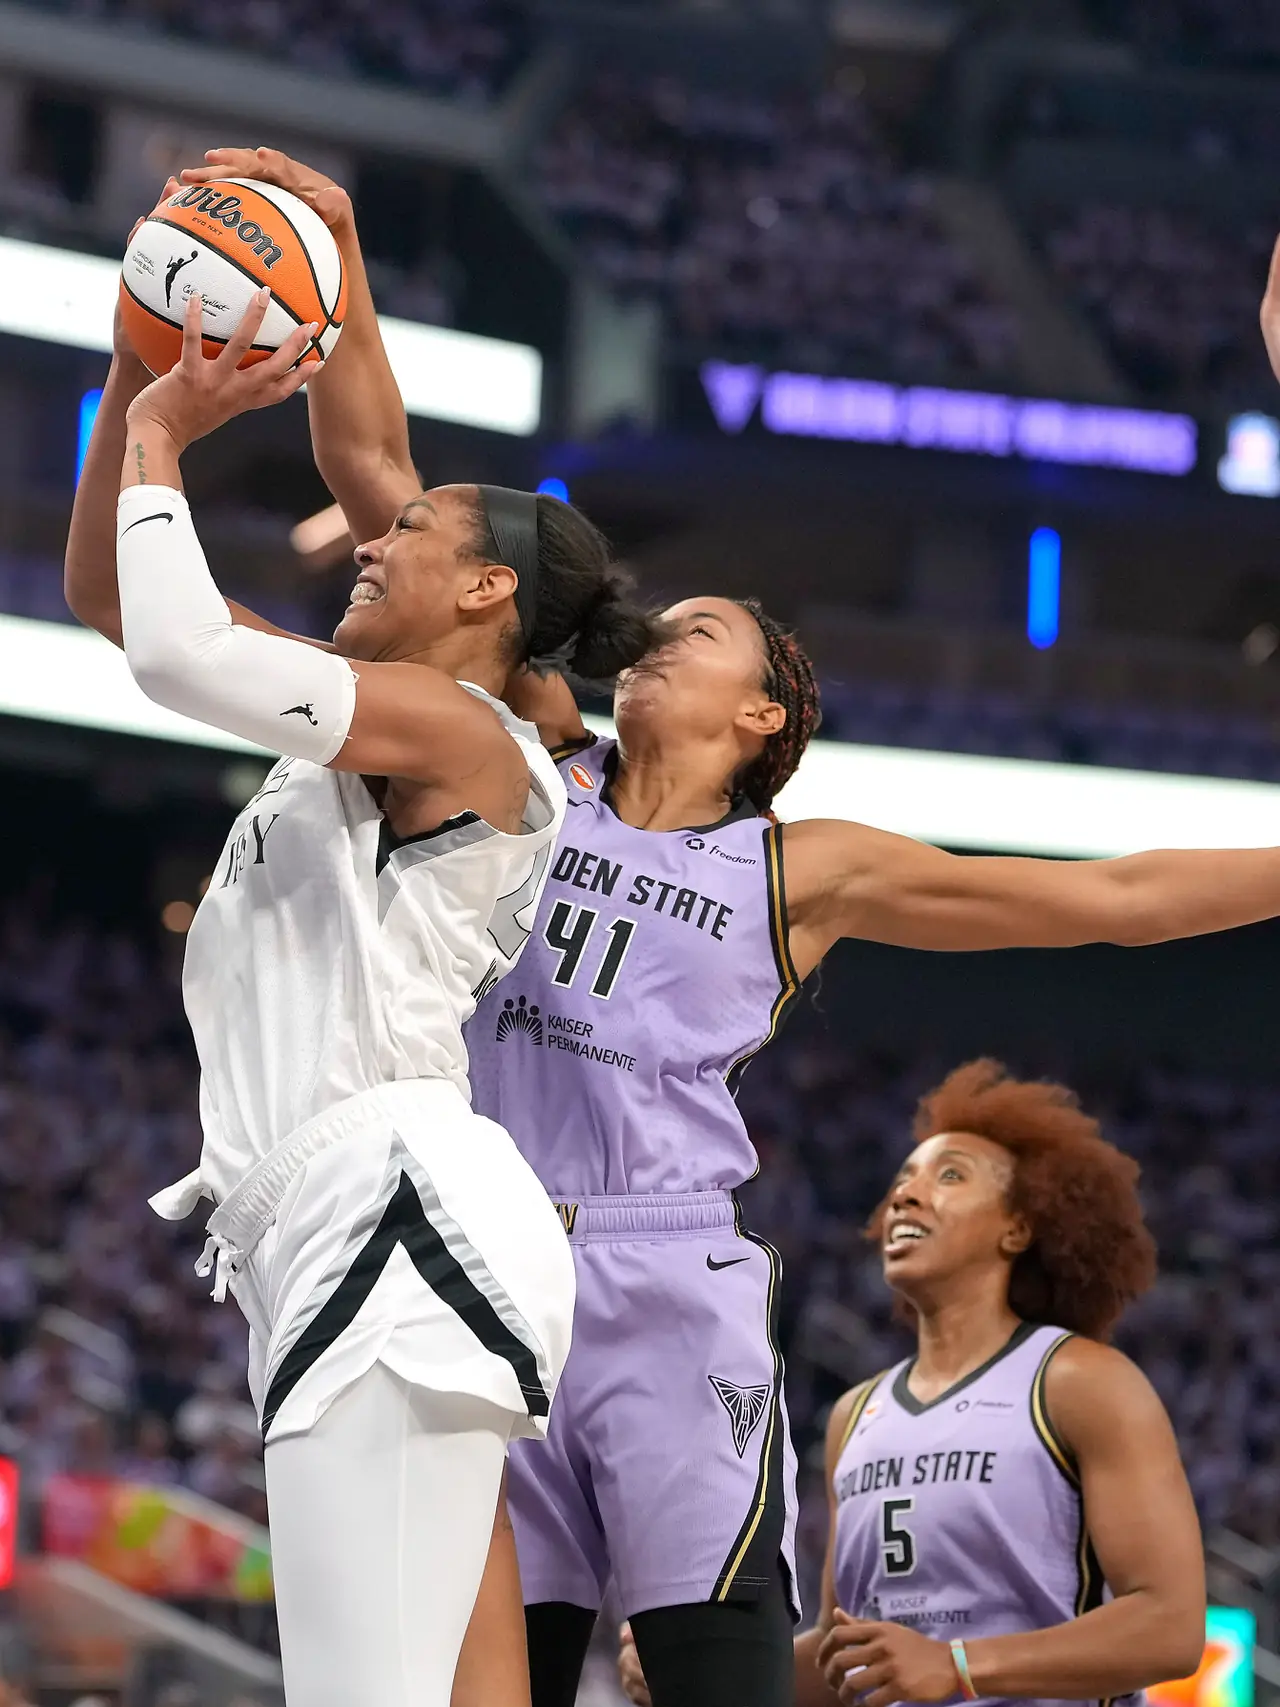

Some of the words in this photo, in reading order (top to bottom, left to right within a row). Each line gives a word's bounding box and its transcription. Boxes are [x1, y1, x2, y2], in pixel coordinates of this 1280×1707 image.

[168, 186, 283, 271] Wilson
[191, 216, 206, 228] EVO
[207, 224, 223, 237] NXT
[709, 845, 756, 866] freedom
[550, 846, 623, 898] DEN
[626, 874, 734, 942] STATE
[542, 898, 638, 1000] 41
[548, 1014, 593, 1038] KAISER
[548, 1035, 636, 1072] PERMANENTE
[912, 1451, 997, 1485] STATE
[881, 1495, 917, 1577] 5
